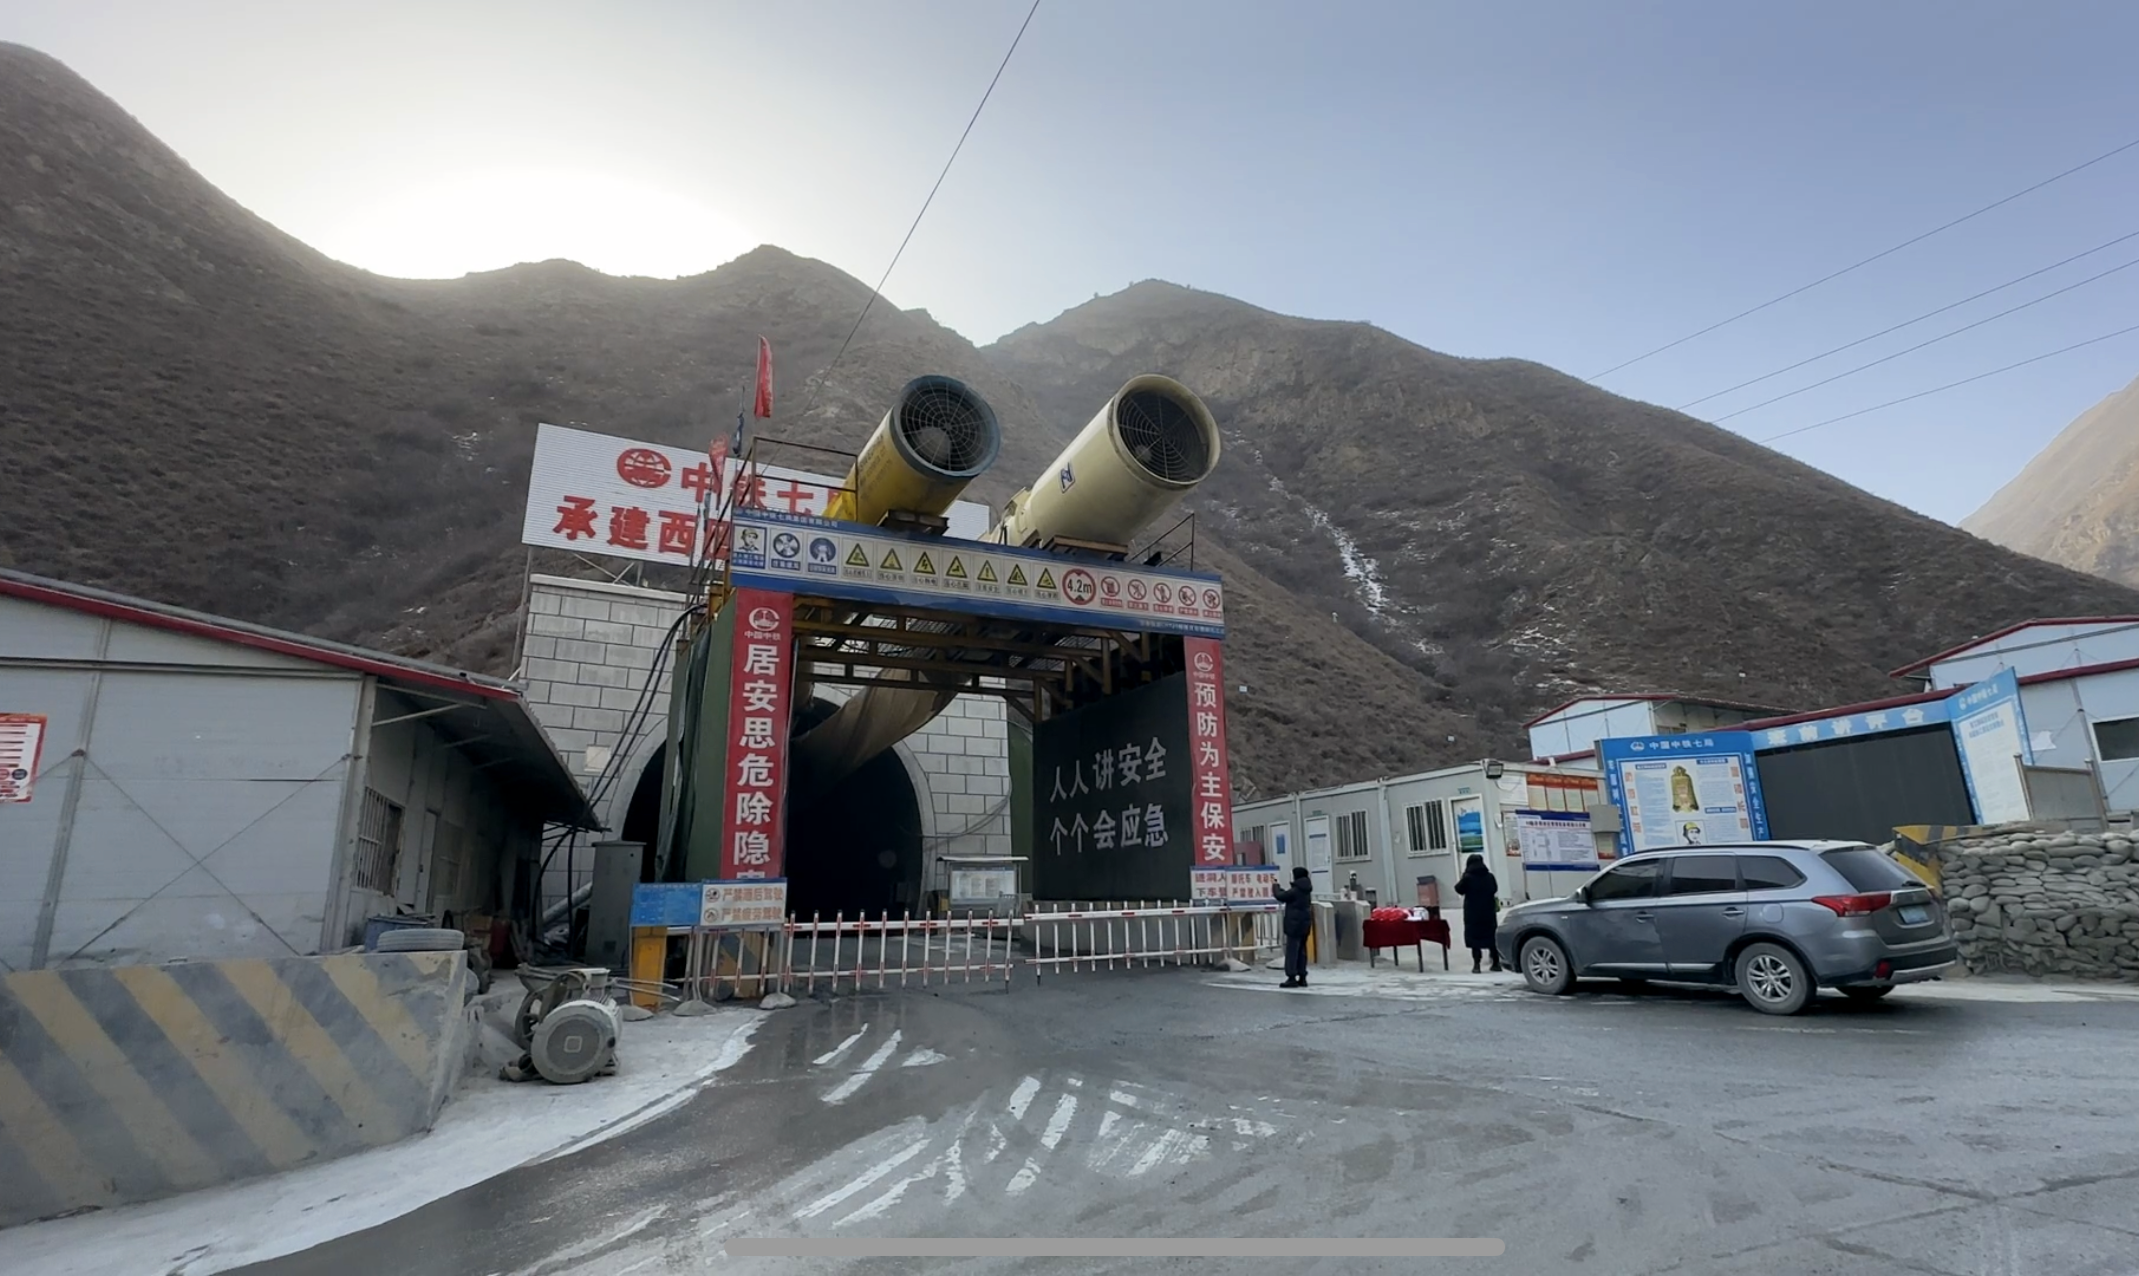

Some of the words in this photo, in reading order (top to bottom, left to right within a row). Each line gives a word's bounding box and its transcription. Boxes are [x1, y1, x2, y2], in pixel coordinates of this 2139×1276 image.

[681, 460, 844, 517] 中铁七
[1067, 577, 1092, 594] 4.2m
[744, 630, 781, 641] 中国中铁
[1050, 736, 1167, 803] 人人讲安全
[1649, 738, 1714, 750] 中国中铁七局
[1194, 682, 1227, 861] 预防为主保安
[1050, 803, 1168, 855] 个个会应急
